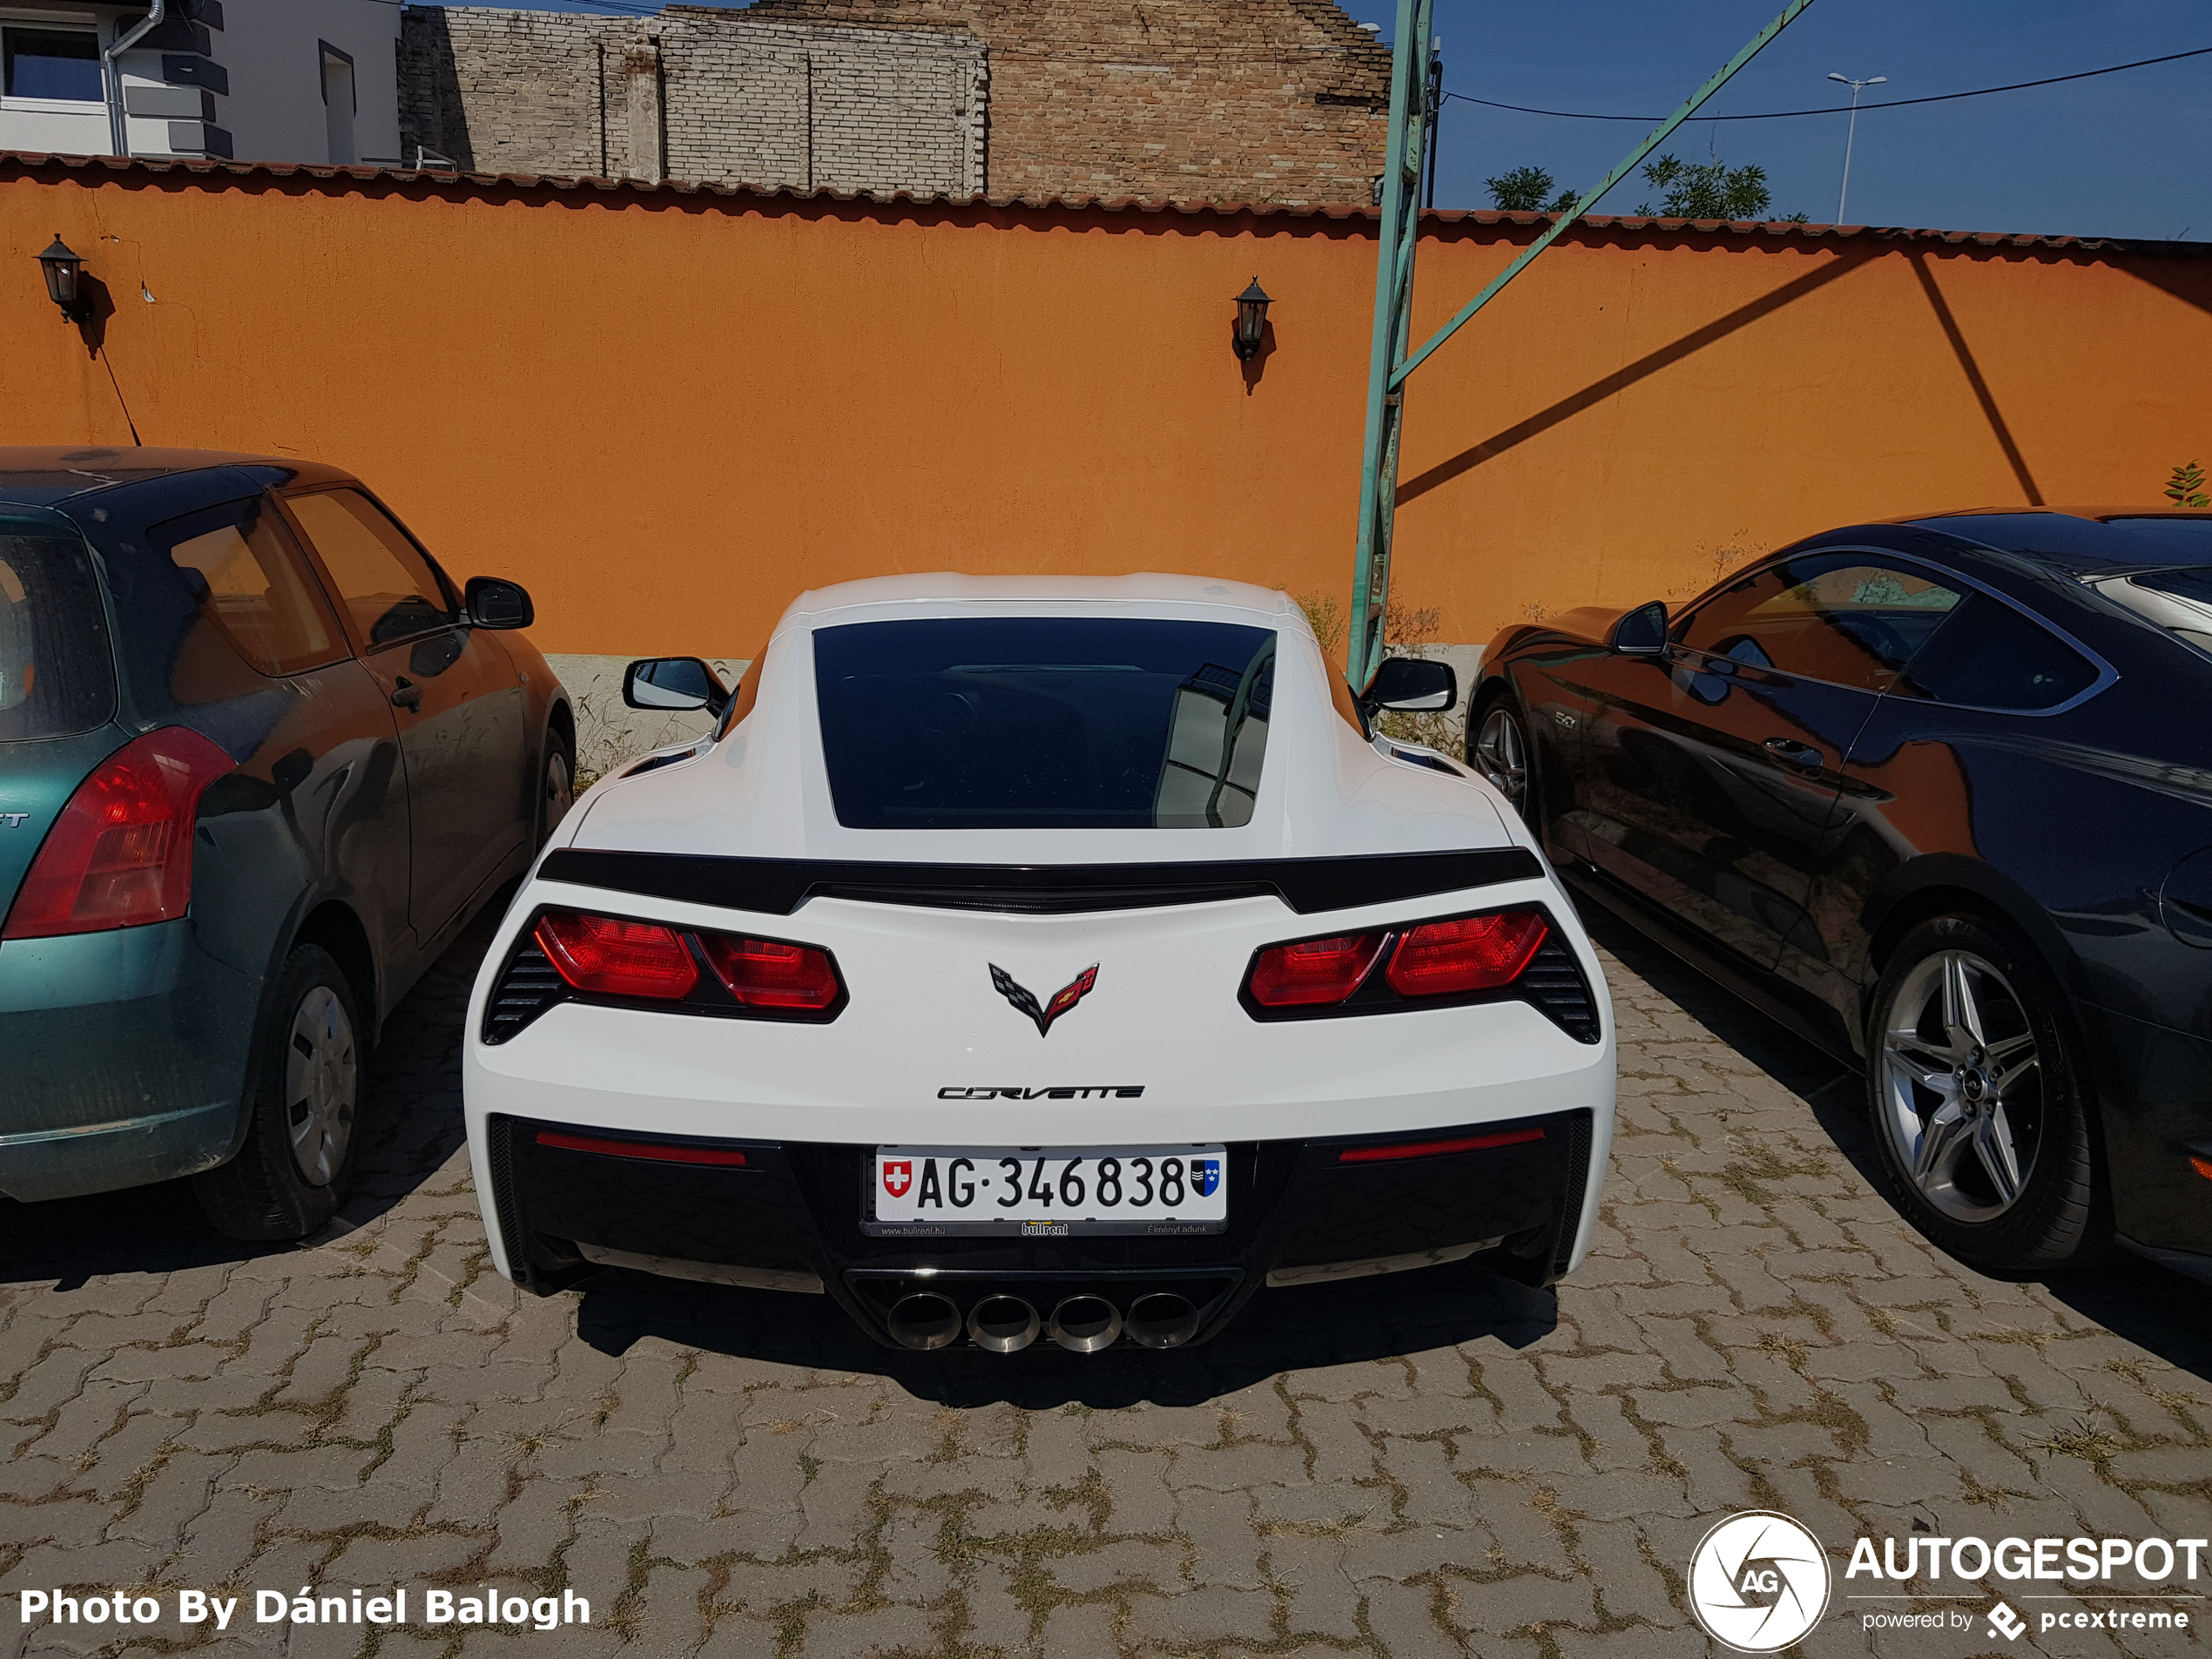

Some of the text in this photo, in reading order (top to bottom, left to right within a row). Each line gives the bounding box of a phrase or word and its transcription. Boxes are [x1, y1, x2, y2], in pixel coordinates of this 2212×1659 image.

[0, 813, 30, 828] T
[937, 1085, 1145, 1100] CORVETTE
[881, 1225, 946, 1235] www.bullrent.hu
[1022, 1221, 1069, 1236] bullrent
[1182, 1224, 1207, 1233] adunk
